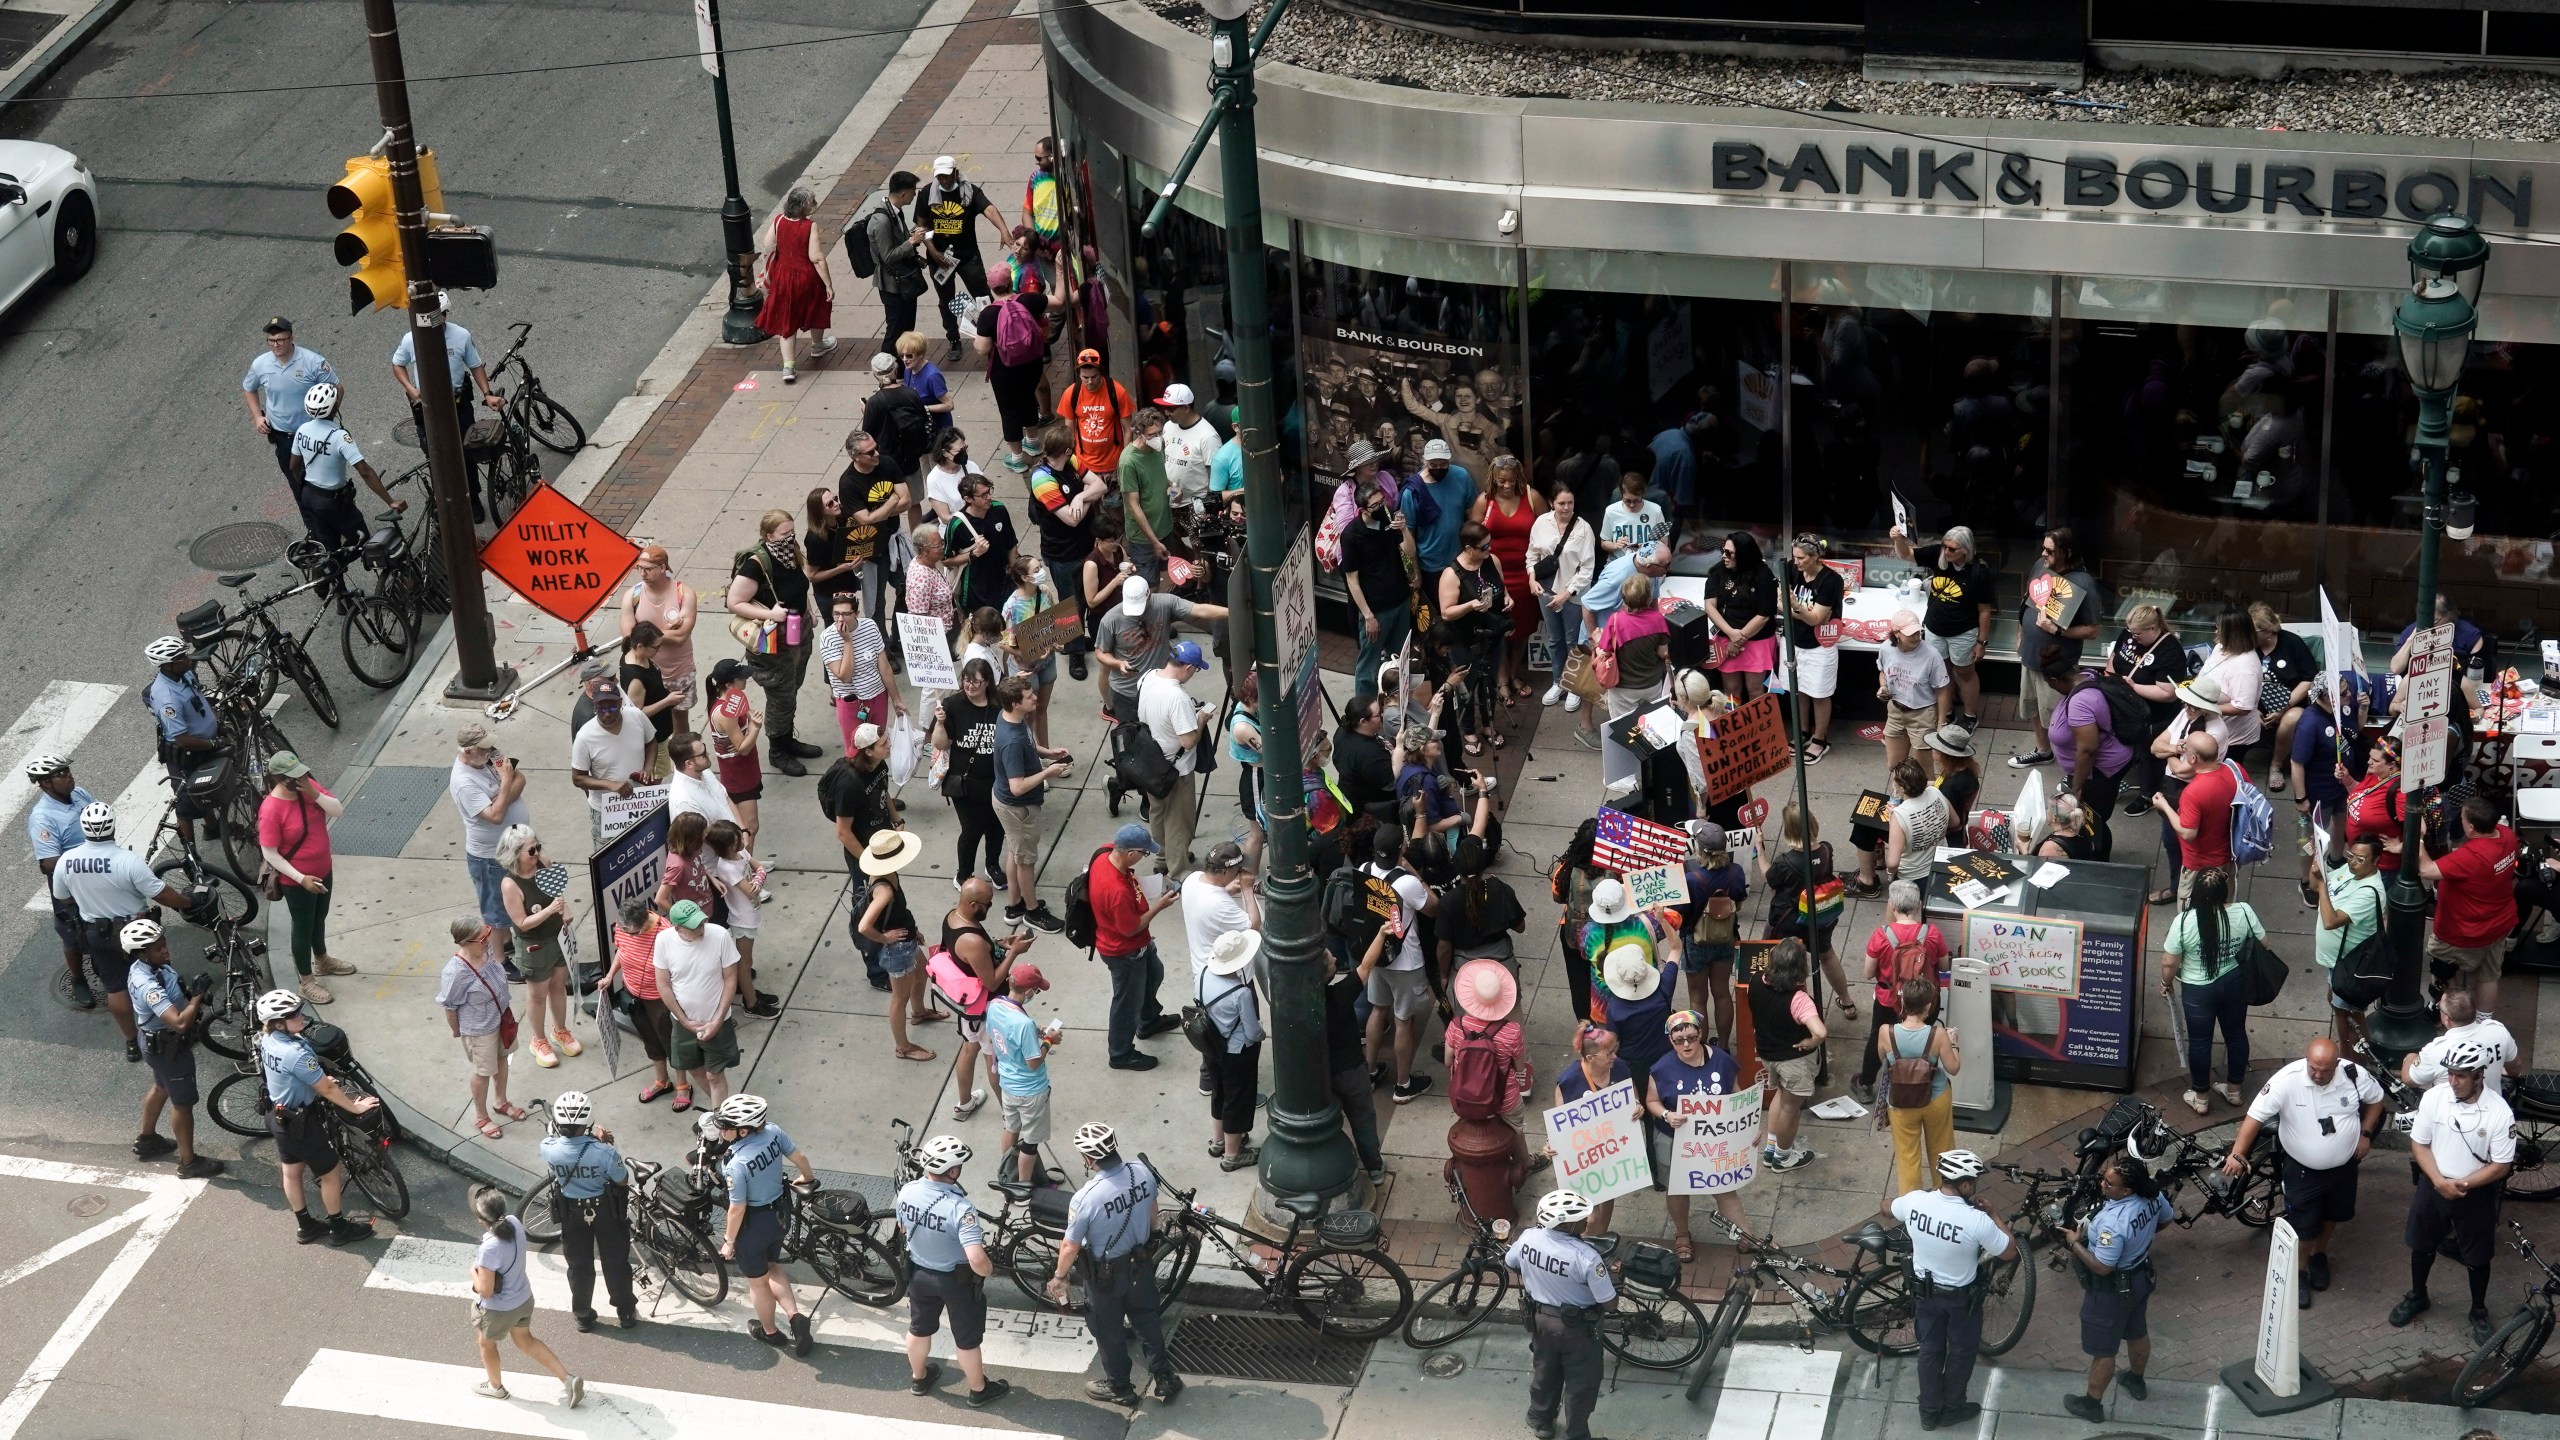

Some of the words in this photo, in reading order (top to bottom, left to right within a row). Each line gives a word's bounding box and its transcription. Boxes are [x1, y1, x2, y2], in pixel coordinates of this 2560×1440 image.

[1712, 140, 1979, 200] BANK
[1996, 152, 2042, 207] &
[2063, 156, 2533, 228] BOURBON
[1336, 327, 1383, 345] BANK
[1386, 336, 1395, 347] &
[1397, 338, 1484, 357] BOURBON
[1082, 405, 1105, 413] ywca
[297, 431, 331, 457] POLICE
[517, 522, 588, 541] UTILITY
[526, 548, 590, 566] WORK
[1290, 531, 1308, 577] BLOCK
[531, 572, 601, 591] AHEAD
[2033, 580, 2049, 597] PFLAG
[900, 614, 909, 625] WE
[913, 616, 922, 626] DO
[924, 618, 937, 628] NOT
[1820, 624, 1838, 637] PFLAG
[1868, 620, 1888, 628] PFLAG
[911, 635, 929, 644] WITH
[1298, 616, 1314, 660] BOX
[2424, 638, 2441, 650] ZONE
[907, 643, 938, 655] DOMESTIC
[907, 652, 944, 664] TERRORISTS
[908, 661, 924, 670] MOMS
[1282, 649, 1297, 689] THE
[2412, 659, 2426, 676] NO
[2426, 652, 2450, 668] PARKING
[915, 675, 954, 685] UNEDUCATED
[2418, 677, 2440, 690] ANY
[725, 694, 742, 715] PFLAG
[2418, 692, 2440, 702] TIME
[1719, 719, 1772, 755] families
[1861, 725, 1882, 736] PFLAG
[2407, 730, 2443, 748] STOPPING
[1708, 740, 1761, 775] UNITE
[1766, 734, 1776, 744] in
[2413, 746, 2434, 761] ANY
[1712, 751, 1766, 791] SUPPORT
[1770, 746, 1783, 760] for
[1756, 756, 1790, 781] CHILDREN
[2411, 760, 2436, 776] TIME
[1744, 804, 1764, 822] PFAG
[1984, 816, 2000, 828] PFLAG
[604, 820, 633, 832] MOMS
[1639, 820, 1678, 848] HATE
[1974, 831, 1992, 850] PFLAG
[609, 831, 655, 871] LOEWS
[1633, 844, 1646, 856] IS
[1651, 846, 1680, 865] NOT
[65, 858, 112, 874] POLICE
[611, 856, 659, 910] VALET
[1630, 869, 1666, 886] BAN
[1635, 880, 1666, 894] GUNS
[1636, 890, 1682, 908] BOOKS
[1645, 886, 1664, 896] NOT
[1994, 924, 2047, 941] BAN
[2095, 940, 2125, 950] Family
[1990, 961, 2010, 977] OT
[2018, 966, 2066, 980] BOOKS
[2088, 1036, 2120, 1044] Welcomed!
[2089, 1029, 2120, 1038] Caregivers
[2096, 1046, 2120, 1054] Today
[1552, 1086, 1633, 1133] PROTECT
[1681, 1098, 1722, 1116] BAN
[1729, 1090, 1759, 1112] THE
[1694, 1107, 1760, 1137] FASCISTS
[1571, 1120, 1615, 1151] OUR
[746, 1135, 782, 1178] POLICE
[1562, 1135, 1629, 1177] LGBTQ+
[1681, 1141, 1728, 1159] SAVE
[1711, 1146, 1750, 1173] THE
[549, 1163, 601, 1180] POLICE
[1568, 1156, 1650, 1196] YOUTH
[1689, 1164, 1754, 1190] BOOKS
[2190, 1172, 2214, 1199] TREK
[1104, 1180, 1150, 1220] POLICE
[901, 1202, 947, 1234] POLICE
[2131, 1191, 2163, 1239] POLICE
[1910, 1208, 1964, 1246] POLICE
[1205, 1228, 1247, 1269] TREK
[1521, 1243, 1570, 1279] POLICE
[2272, 1270, 2286, 1286] 12th
[1777, 1276, 1814, 1310] TREK
[2264, 1287, 2278, 1361] STREET
